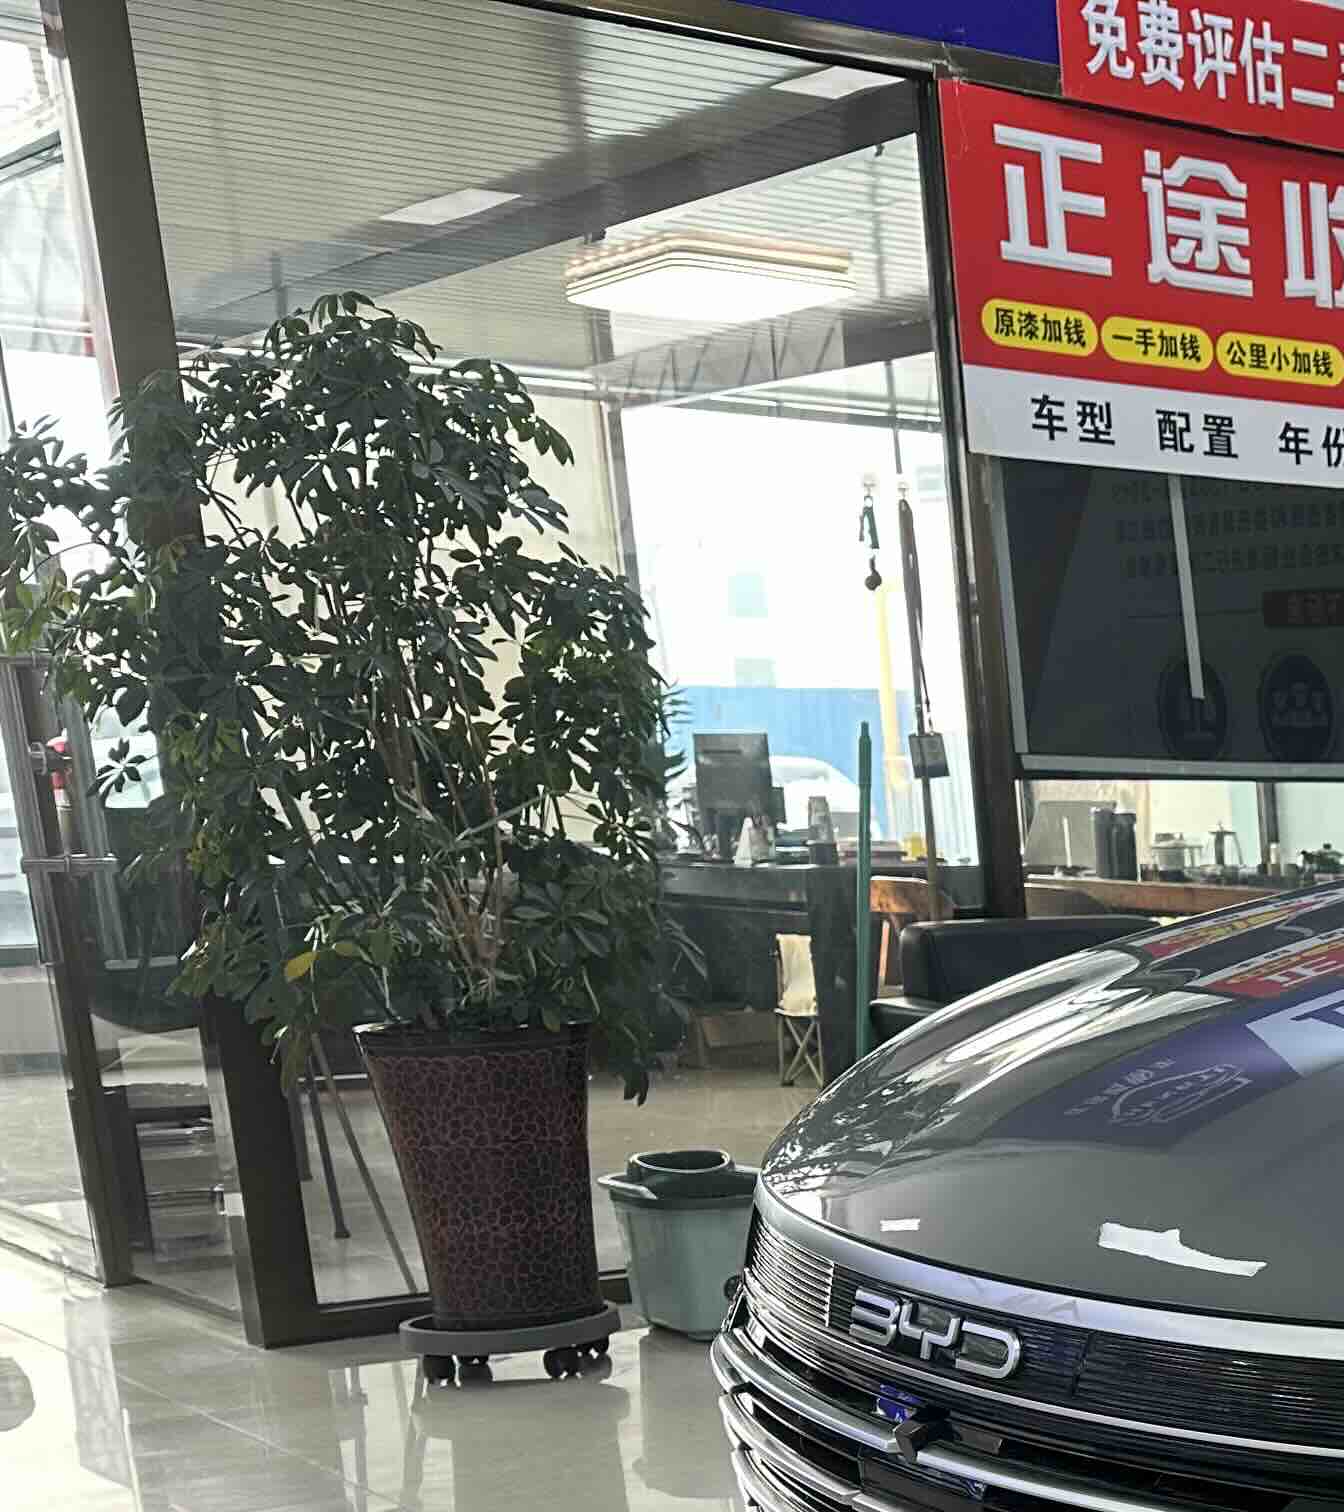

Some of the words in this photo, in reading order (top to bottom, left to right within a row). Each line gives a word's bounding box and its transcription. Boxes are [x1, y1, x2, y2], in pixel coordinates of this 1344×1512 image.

[994, 308, 1087, 347] 原漆加钱
[1112, 328, 1201, 362] 一手加钱
[1226, 340, 1333, 378] 公里小加钱
[1031, 395, 1115, 446] 车型
[1156, 409, 1239, 459] 配置
[850, 1286, 1020, 1379] BYD
